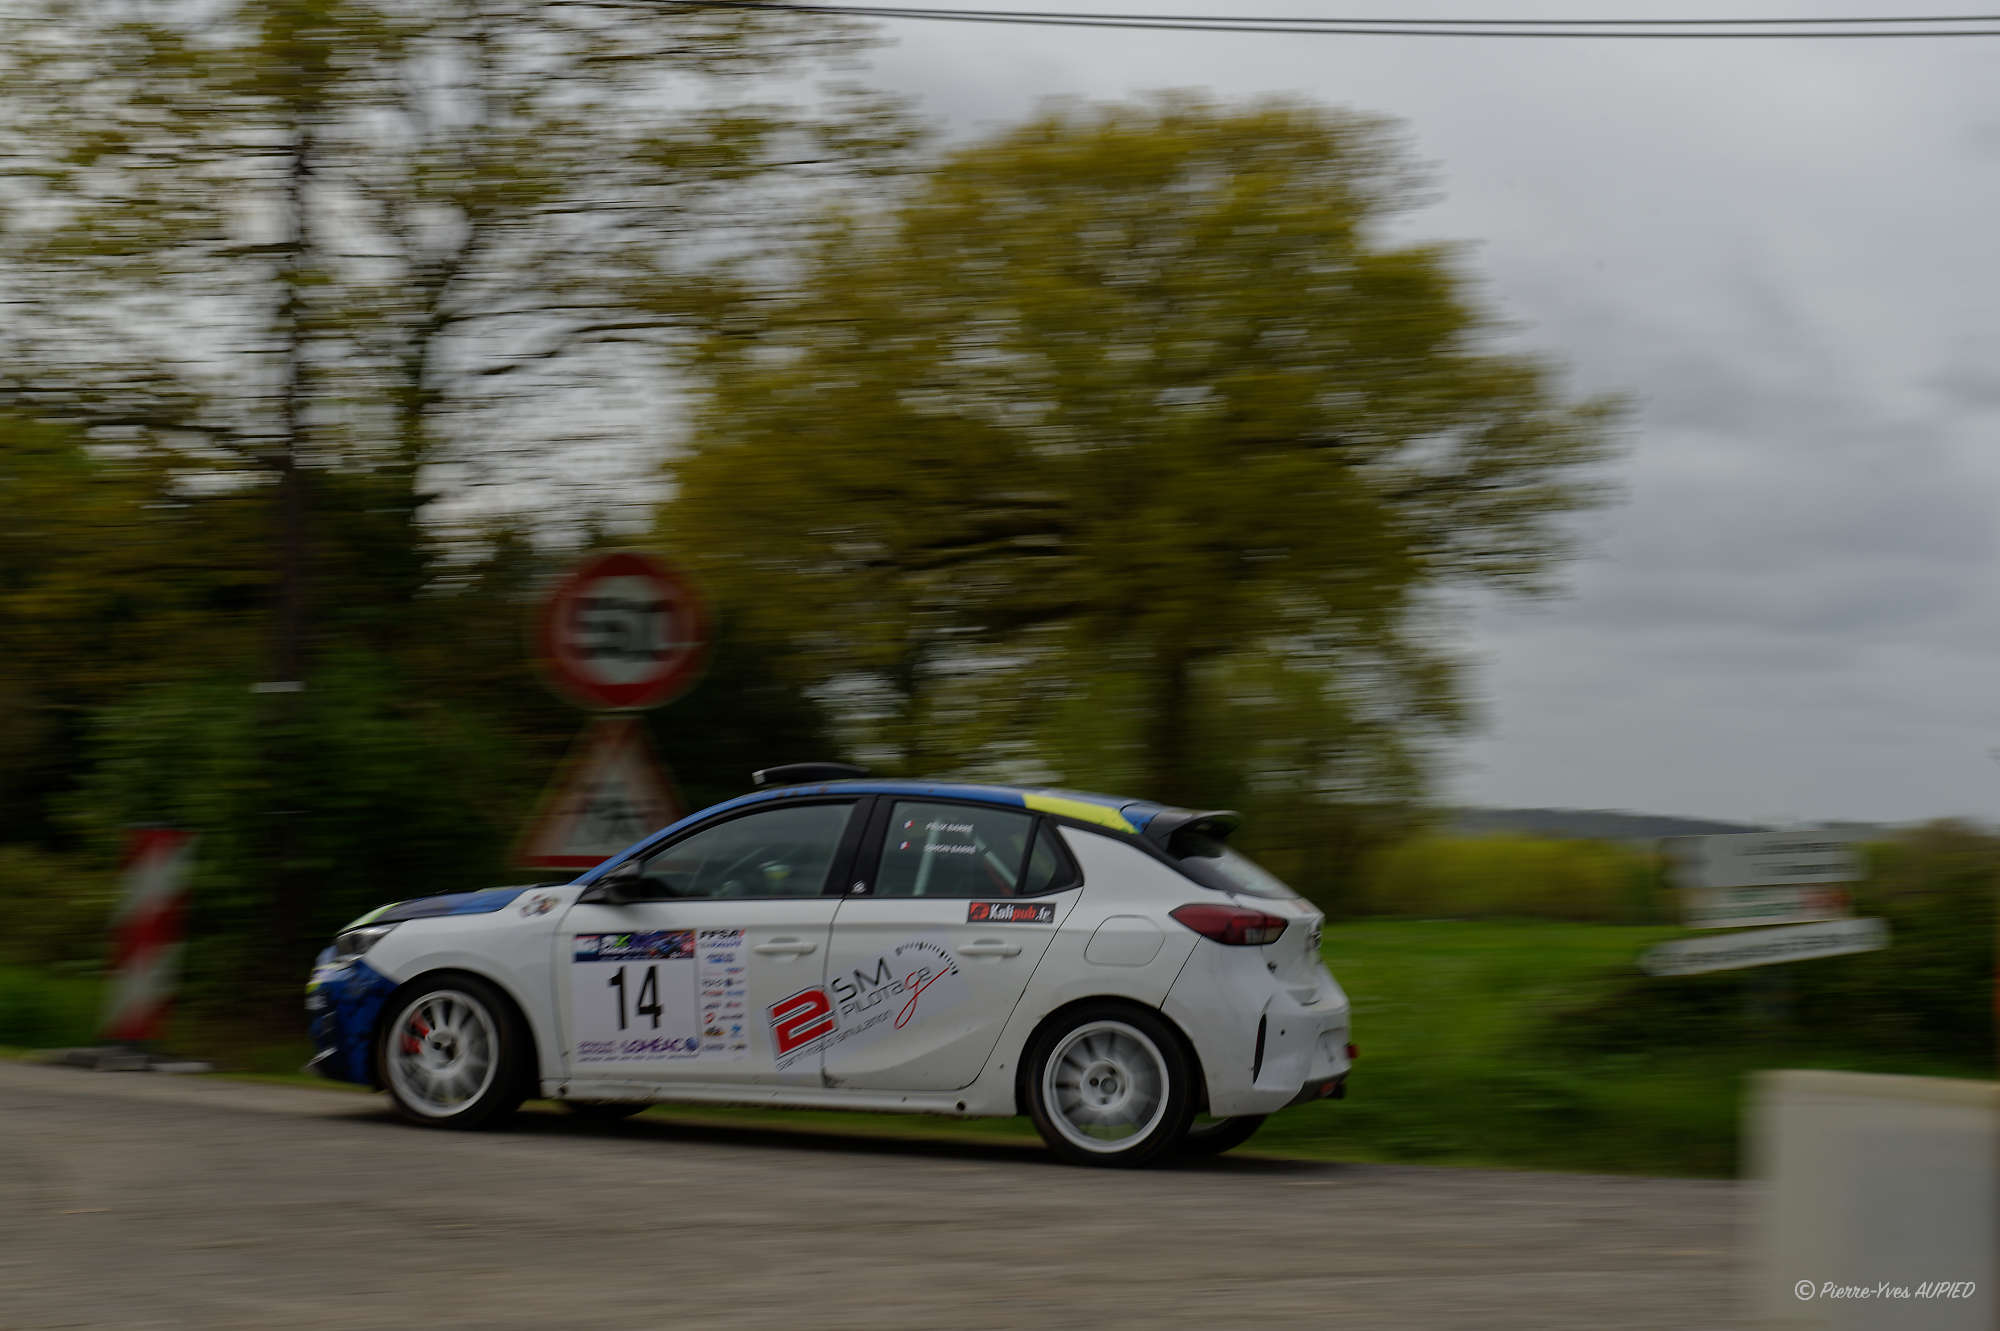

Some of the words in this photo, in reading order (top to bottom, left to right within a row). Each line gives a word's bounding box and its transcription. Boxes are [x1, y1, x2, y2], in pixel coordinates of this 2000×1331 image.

[608, 964, 663, 1031] 14
[831, 957, 893, 1004] SM
[772, 988, 836, 1056] 2
